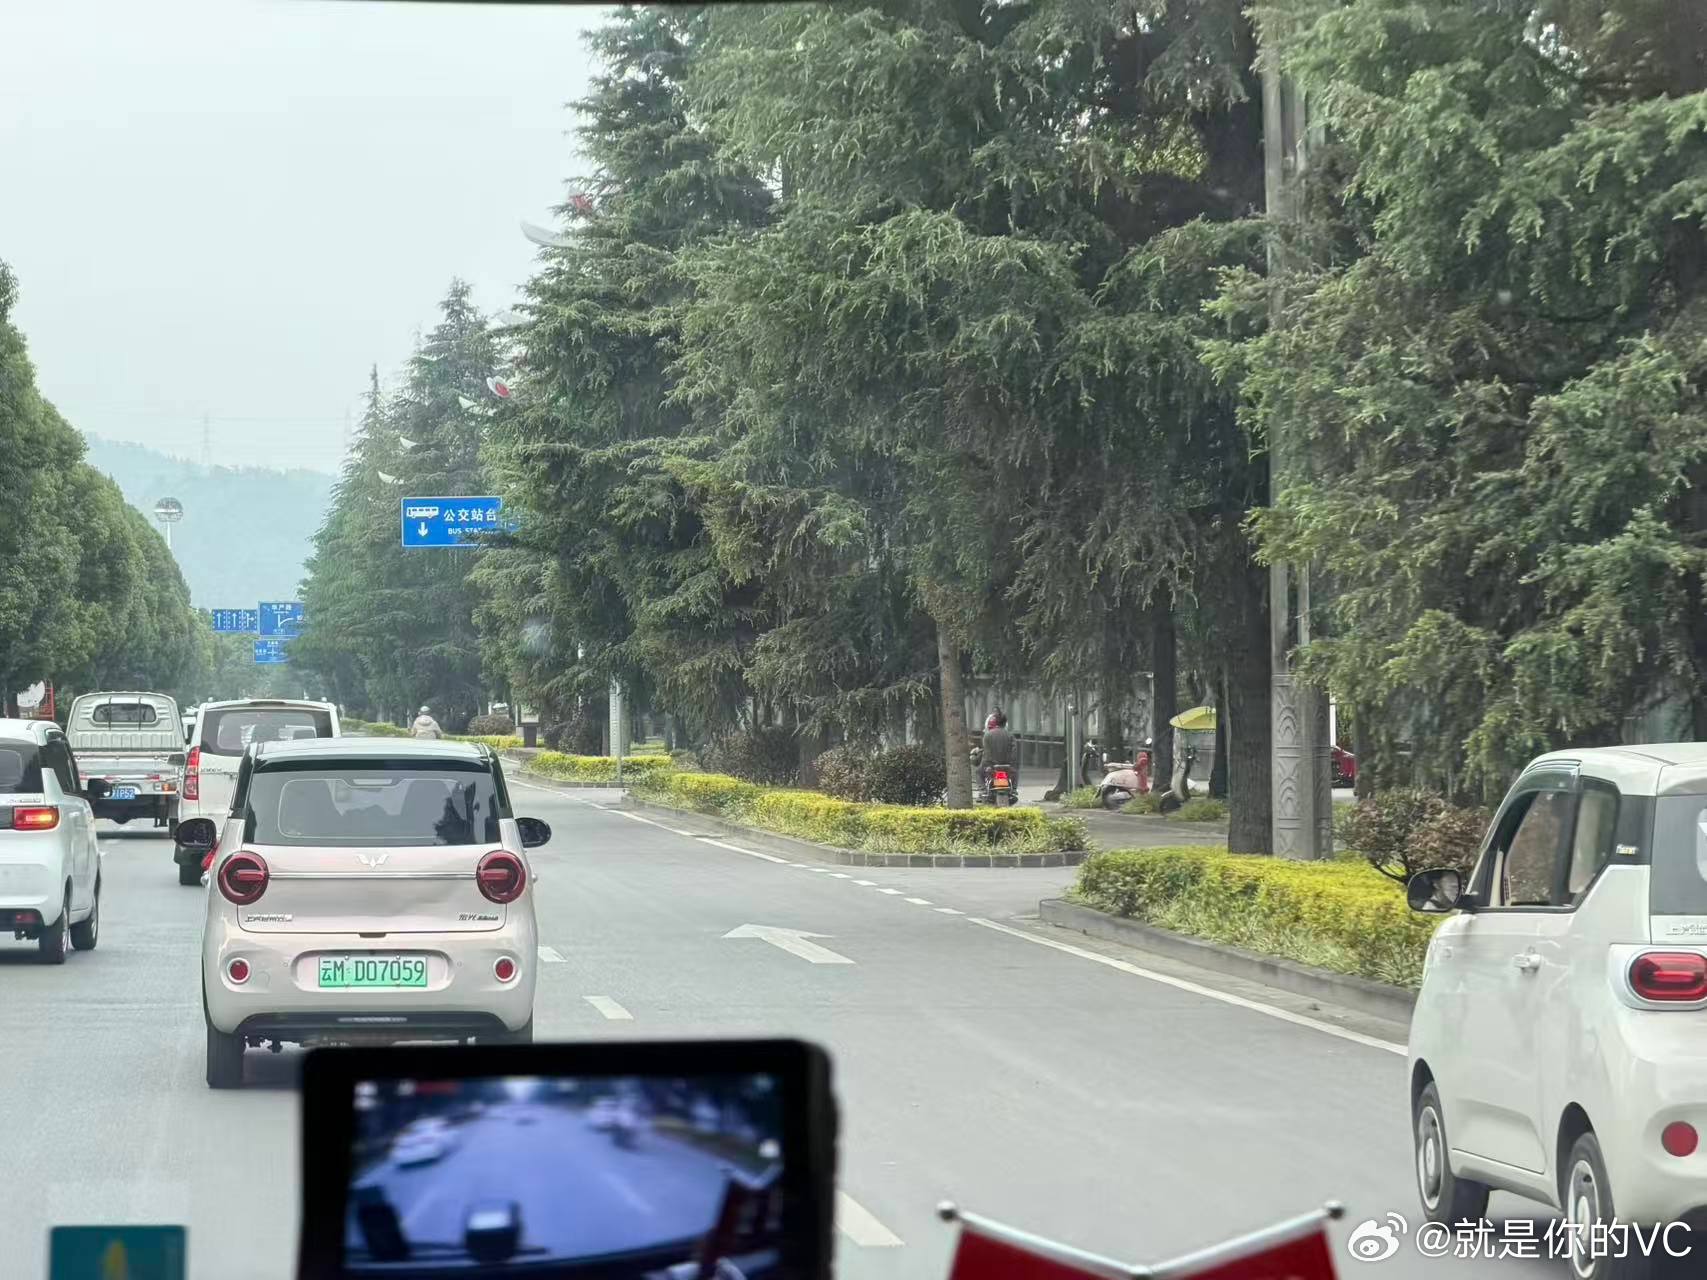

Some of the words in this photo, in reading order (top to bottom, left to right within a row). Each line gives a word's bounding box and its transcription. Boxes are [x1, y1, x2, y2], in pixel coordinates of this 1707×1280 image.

[443, 508, 497, 522] 公交站台
[448, 527, 462, 535] BUS
[355, 959, 425, 981] D07059
